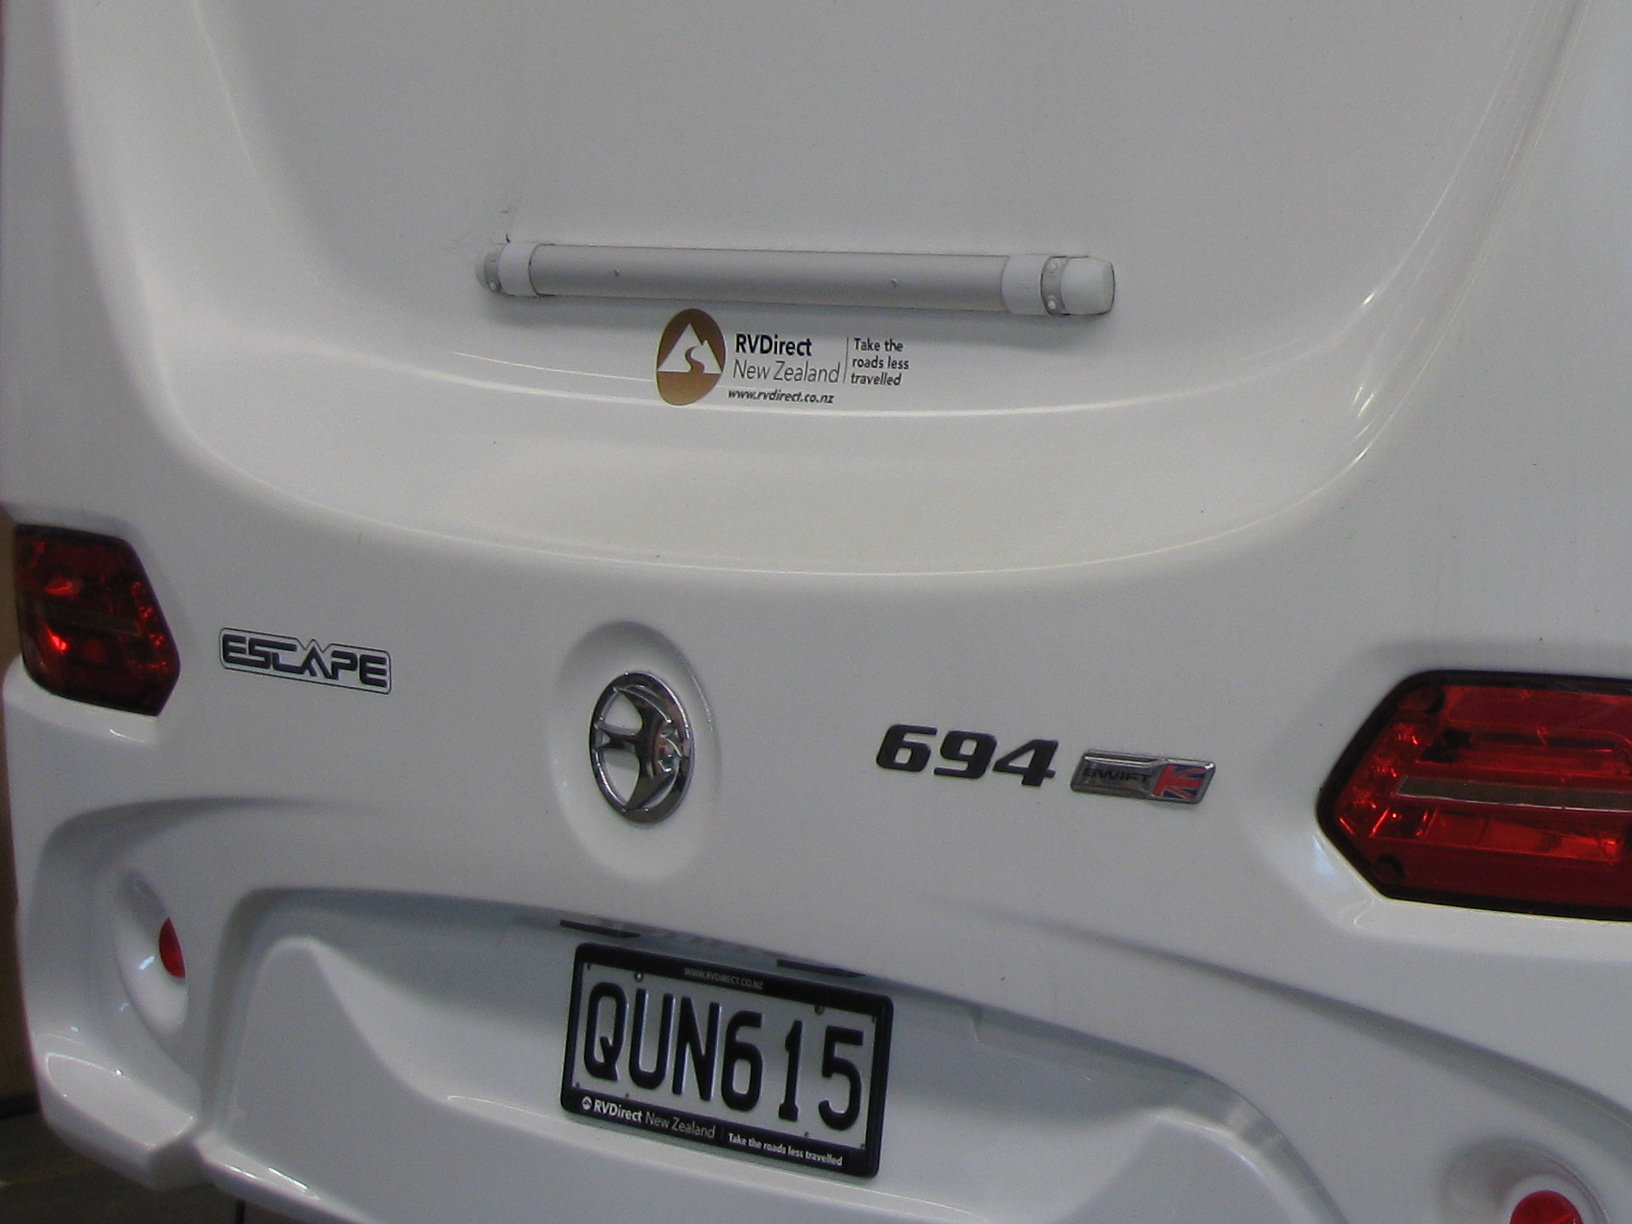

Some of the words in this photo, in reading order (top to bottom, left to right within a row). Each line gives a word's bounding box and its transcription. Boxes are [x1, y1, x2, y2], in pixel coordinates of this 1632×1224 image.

[735, 333, 812, 357] RVDirect
[854, 338, 881, 352] Take
[884, 338, 904, 352] the
[732, 359, 771, 380] New
[772, 360, 841, 384] Zealand
[852, 356, 884, 369] roads
[887, 357, 909, 370] less
[850, 373, 901, 386] travelled
[728, 389, 834, 404] www.rvdirect.co.nz
[222, 633, 388, 688] ESCAPE
[876, 723, 1059, 788] 694
[583, 981, 865, 1131] QUN615
[593, 1099, 643, 1123] RVDirect
[645, 1111, 670, 1129] New
[671, 1116, 716, 1138] Zealand
[728, 1132, 748, 1145] Take
[748, 1137, 762, 1150] the
[763, 1142, 787, 1154] roads
[787, 1145, 804, 1158] less
[805, 1150, 843, 1166] travelled
